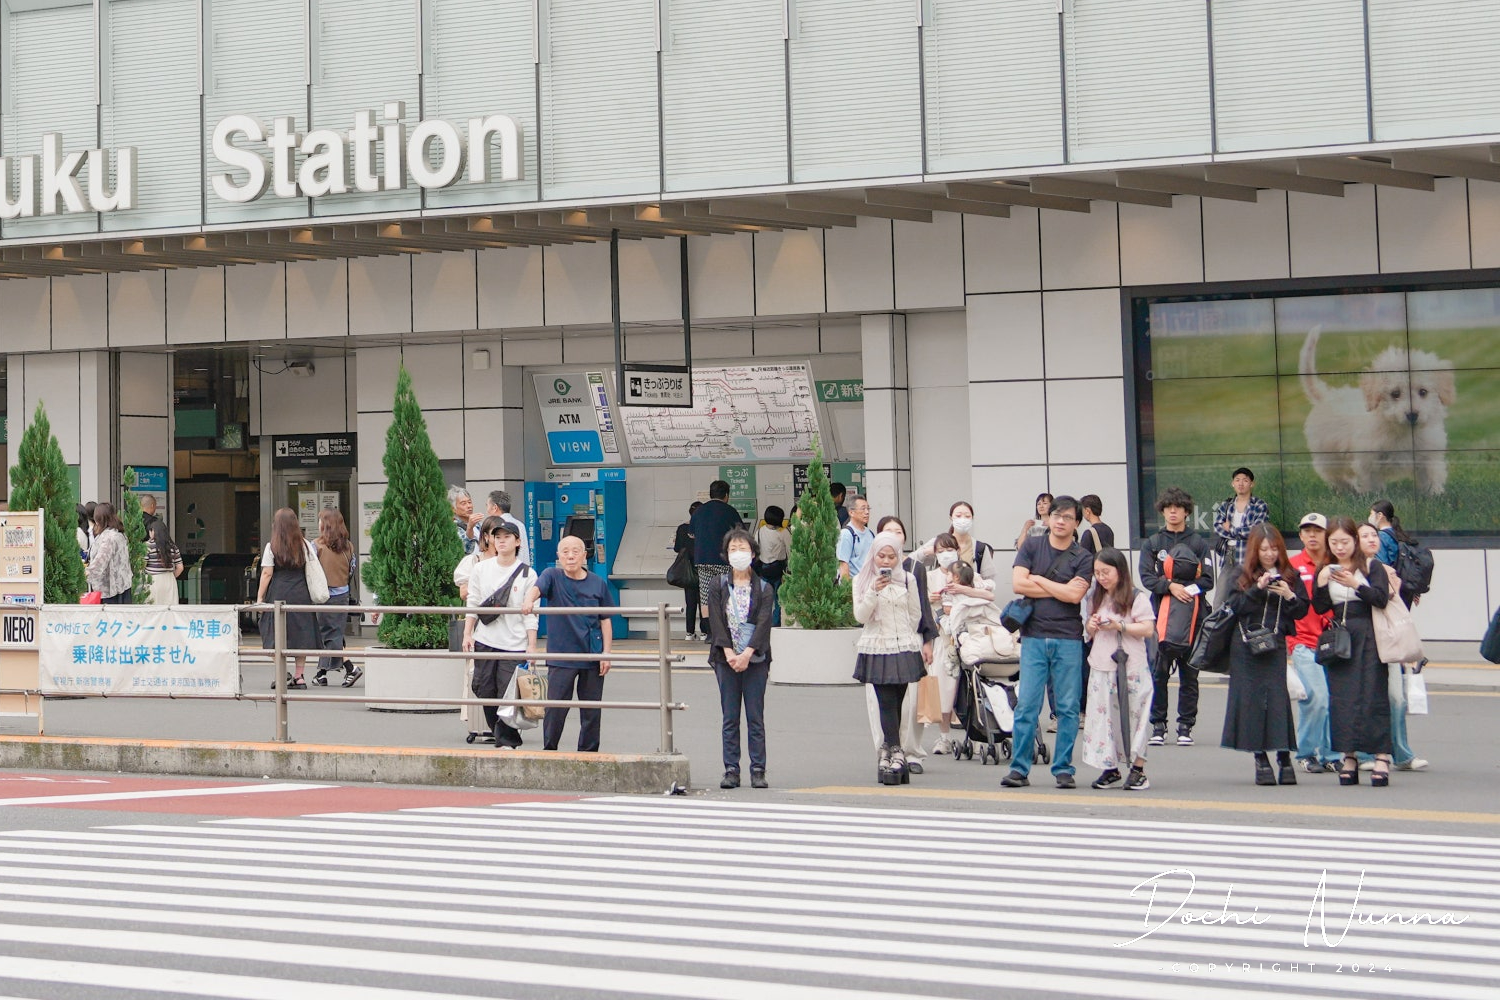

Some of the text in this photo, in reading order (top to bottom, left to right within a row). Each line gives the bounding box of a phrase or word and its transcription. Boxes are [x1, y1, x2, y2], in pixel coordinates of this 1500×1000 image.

[210, 101, 525, 203] Station
[643, 377, 683, 390] きっぷうりば
[644, 391, 658, 399] Tickets
[559, 413, 581, 425] ATM
[726, 468, 749, 478] きっぷ
[3, 616, 35, 643] NERO
[95, 618, 232, 640] タクシー・一般車の
[72, 644, 197, 665] 乗降は出来ません
[132, 676, 169, 687] 国土交通省
